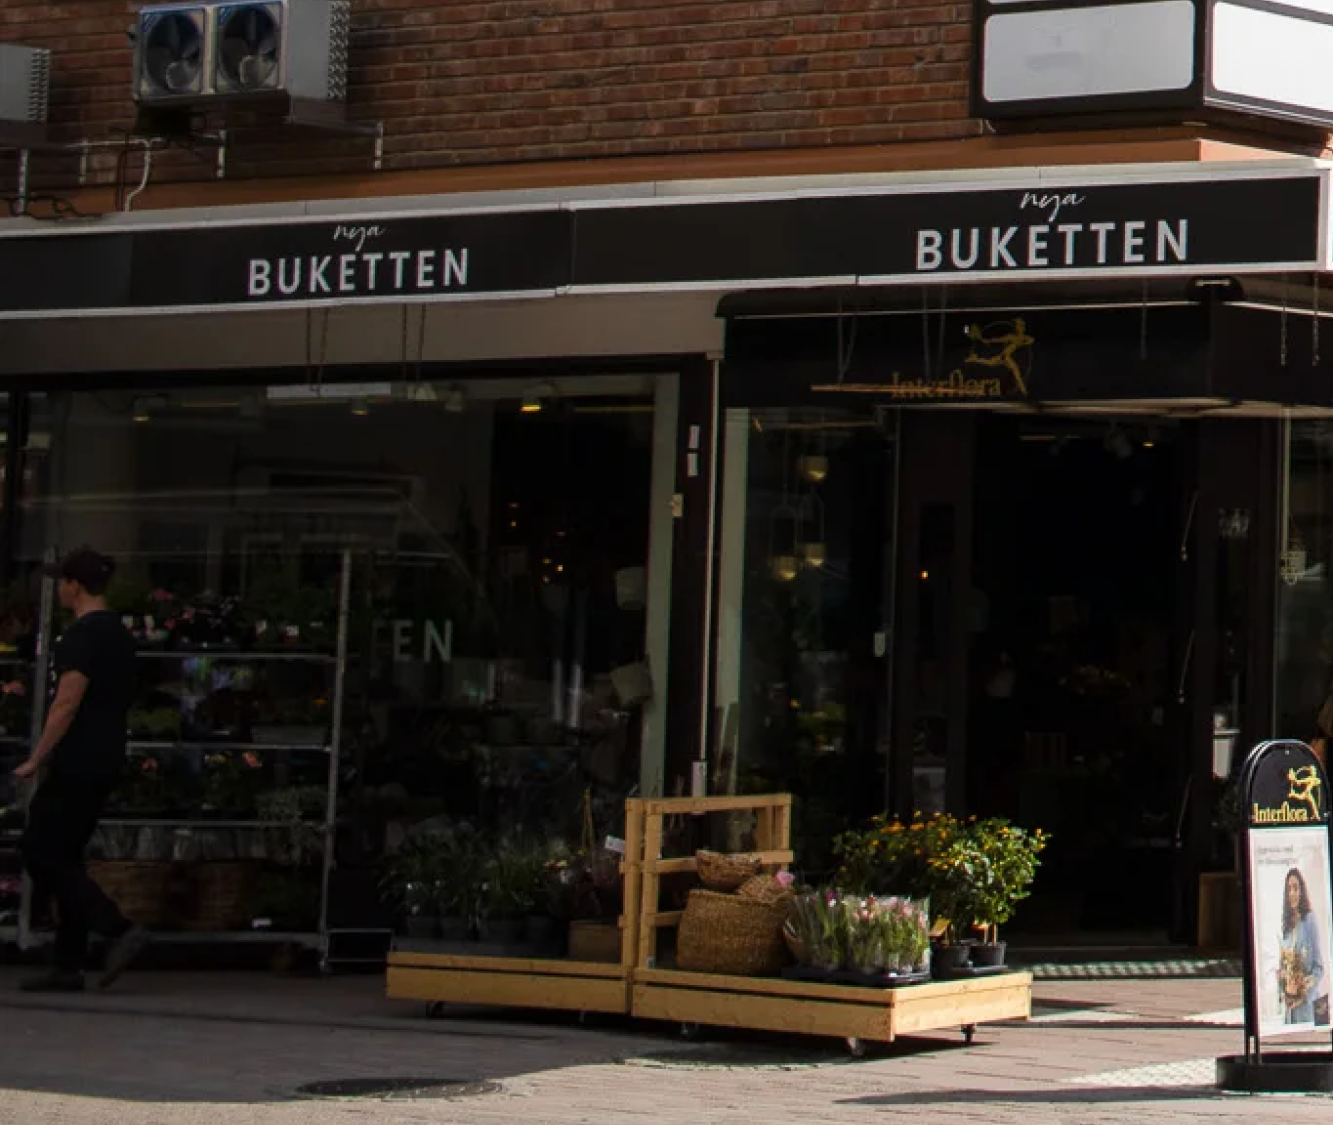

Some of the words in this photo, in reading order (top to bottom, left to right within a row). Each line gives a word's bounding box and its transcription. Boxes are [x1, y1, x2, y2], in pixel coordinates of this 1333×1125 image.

[1019, 188, 1087, 222] nya
[333, 223, 388, 251] nya
[916, 219, 1188, 271] BUKETTEN
[248, 248, 470, 296] BUKETTEN
[891, 368, 1001, 398] Interflora
[1253, 801, 1308, 823] Interflora
